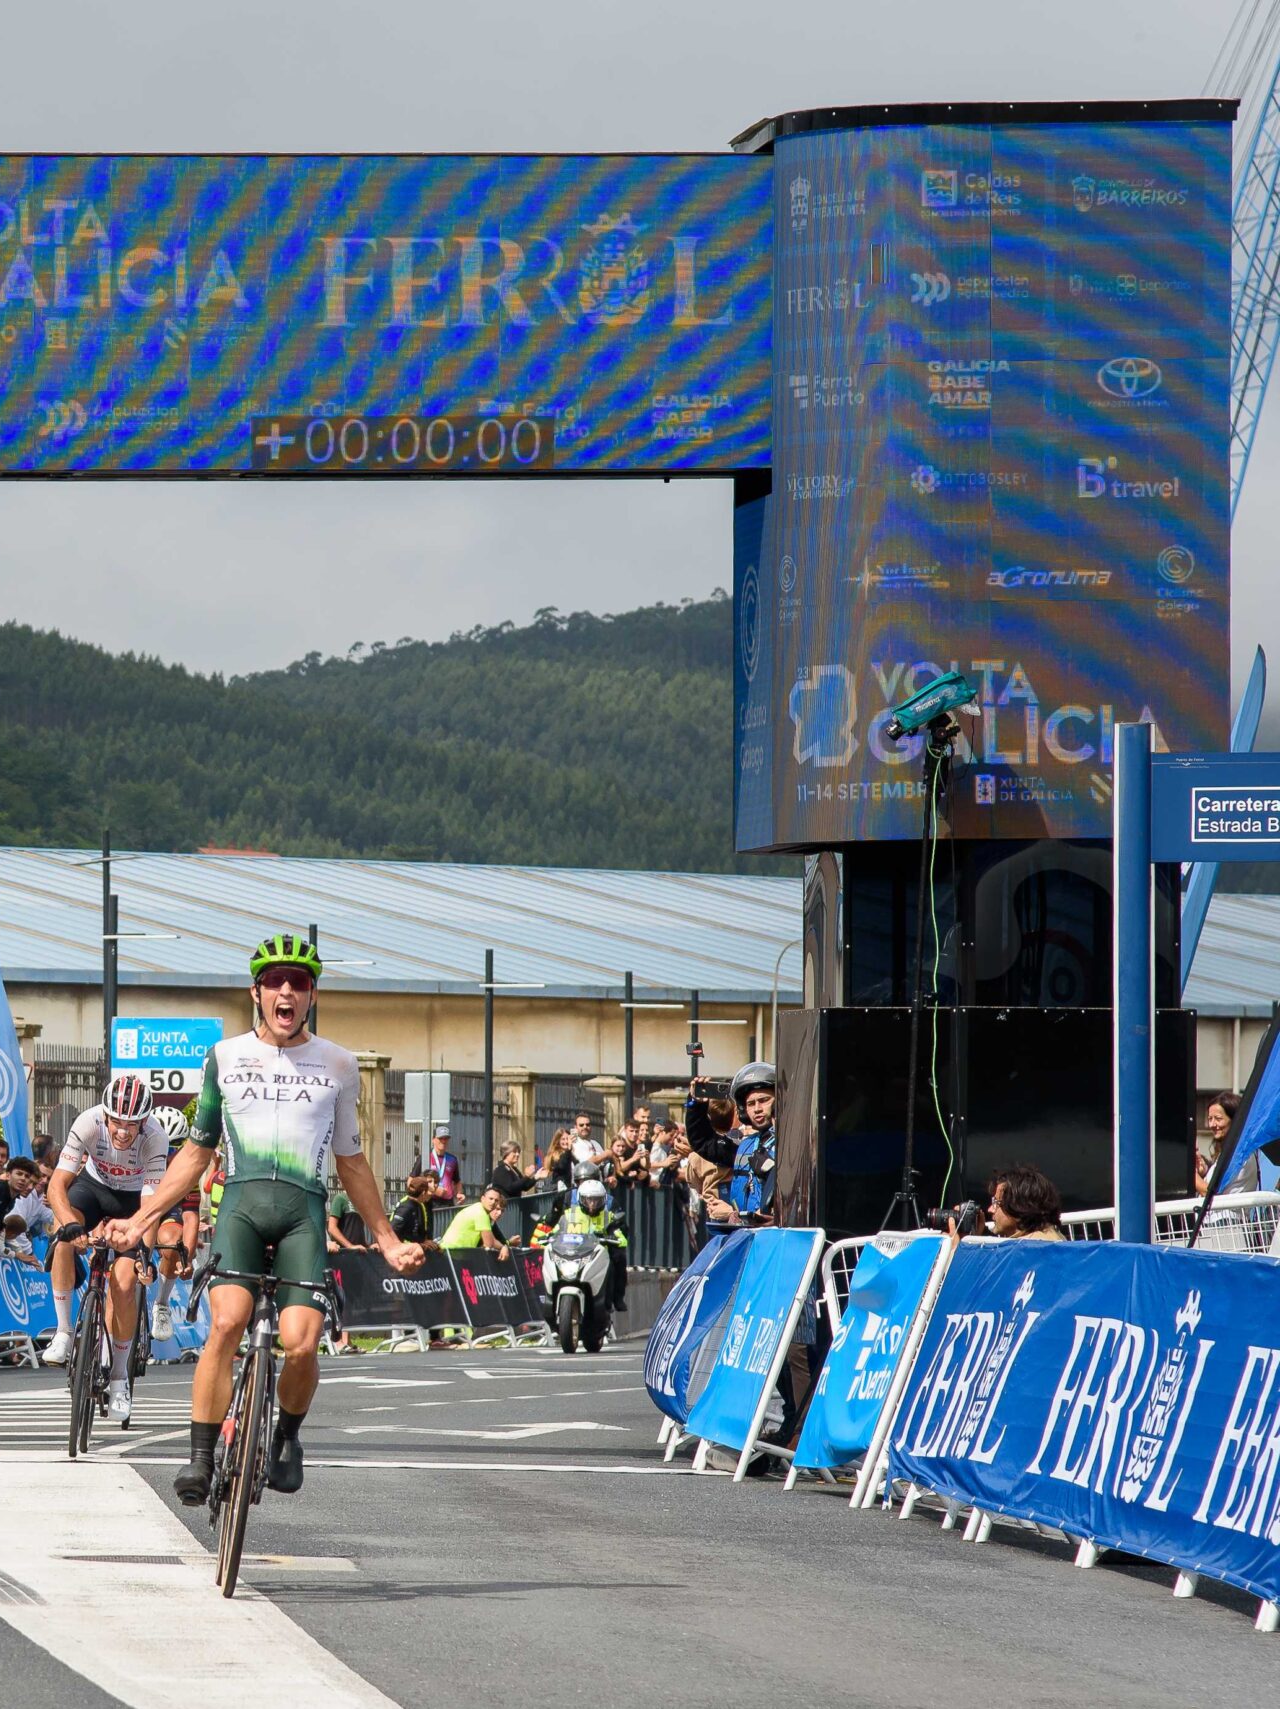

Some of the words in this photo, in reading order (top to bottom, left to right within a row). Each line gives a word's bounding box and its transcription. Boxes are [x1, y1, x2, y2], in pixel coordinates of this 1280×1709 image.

[965, 173, 1021, 188] Caldas
[985, 189, 1021, 205] Reis
[1097, 188, 1189, 208] BARREIROS
[927, 360, 1011, 373] GALICIA
[813, 374, 857, 390] Ferrol
[813, 391, 865, 407] Puerto
[928, 391, 992, 404] AMAR
[1111, 477, 1179, 499] travel
[871, 659, 1039, 705] VOTA
[796, 784, 833, 801] 11-14
[837, 781, 927, 801] SETEMBR
[1197, 797, 1280, 812] Carretera
[1198, 817, 1262, 833] Estrada
[142, 1031, 189, 1043] XUNTA
[141, 1045, 159, 1057] DE
[163, 1045, 208, 1057] GALICI
[150, 1069, 185, 1091] 50
[223, 1071, 266, 1084] CAJA
[273, 1073, 334, 1089] RURAL
[240, 1086, 313, 1103] ALEA
[24, 1277, 49, 1300] Galego
[383, 1277, 452, 1296] OTTOBOSLEY.COM
[474, 1274, 519, 1297] OTTOBOSLEY
